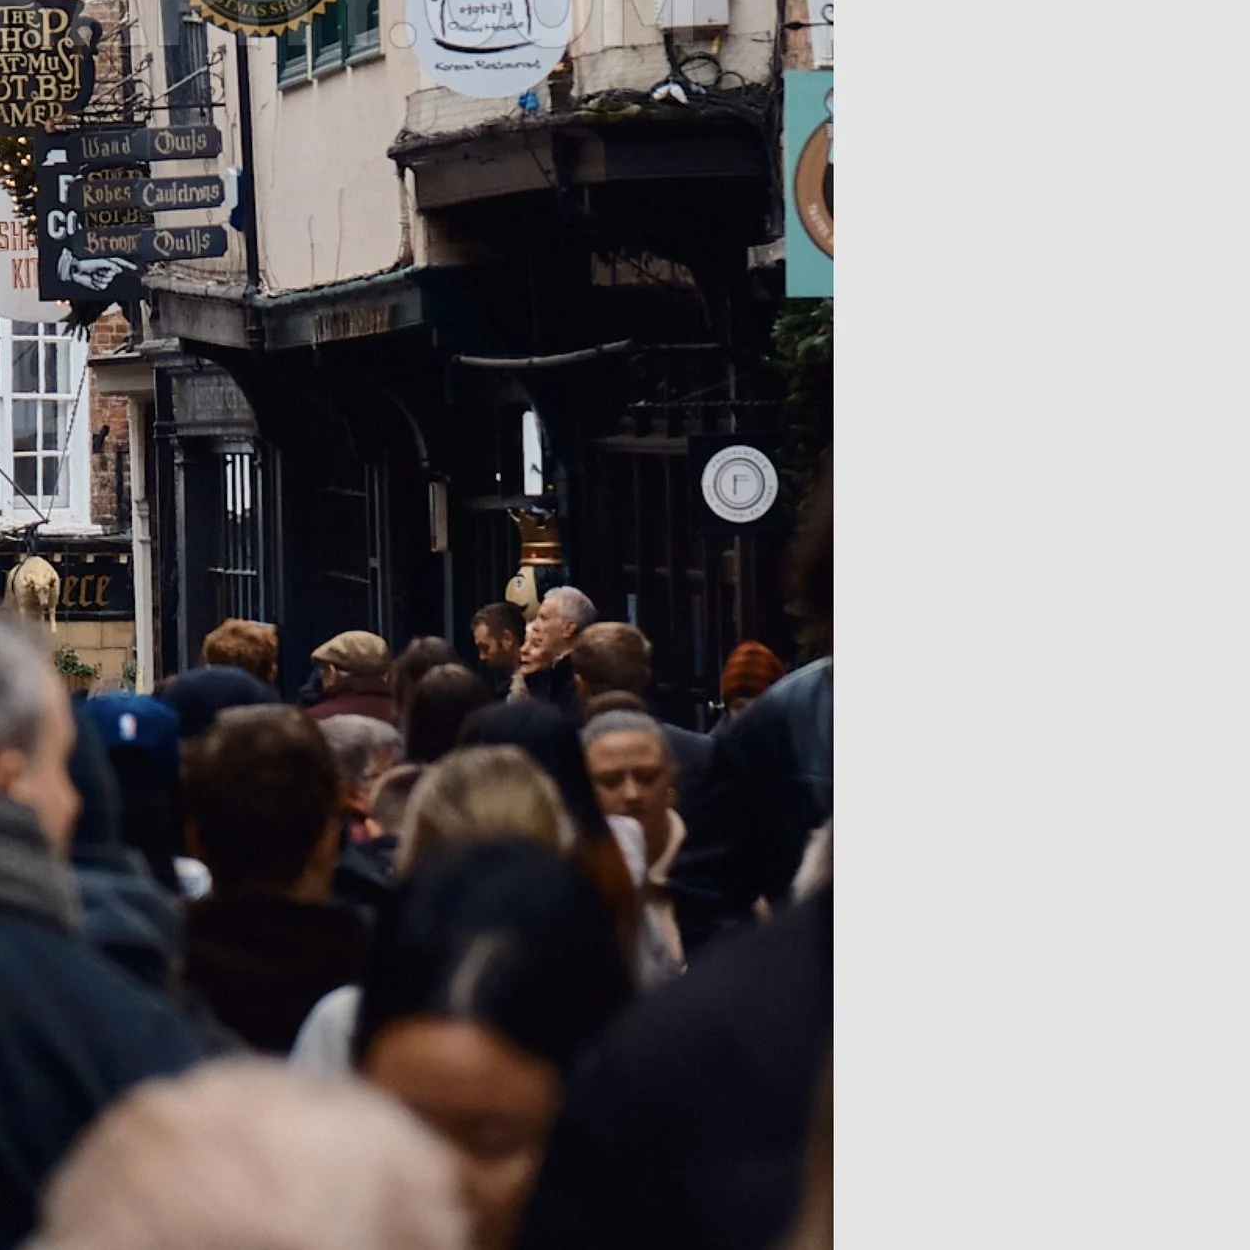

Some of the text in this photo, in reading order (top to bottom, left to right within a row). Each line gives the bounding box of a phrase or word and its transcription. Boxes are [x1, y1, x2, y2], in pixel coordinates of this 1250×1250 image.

[435, 58, 541, 71] Korean Restaurant
[30, 72, 78, 102] BE
[82, 181, 220, 207] Robes Cauldrons
[153, 228, 211, 257] Quills
